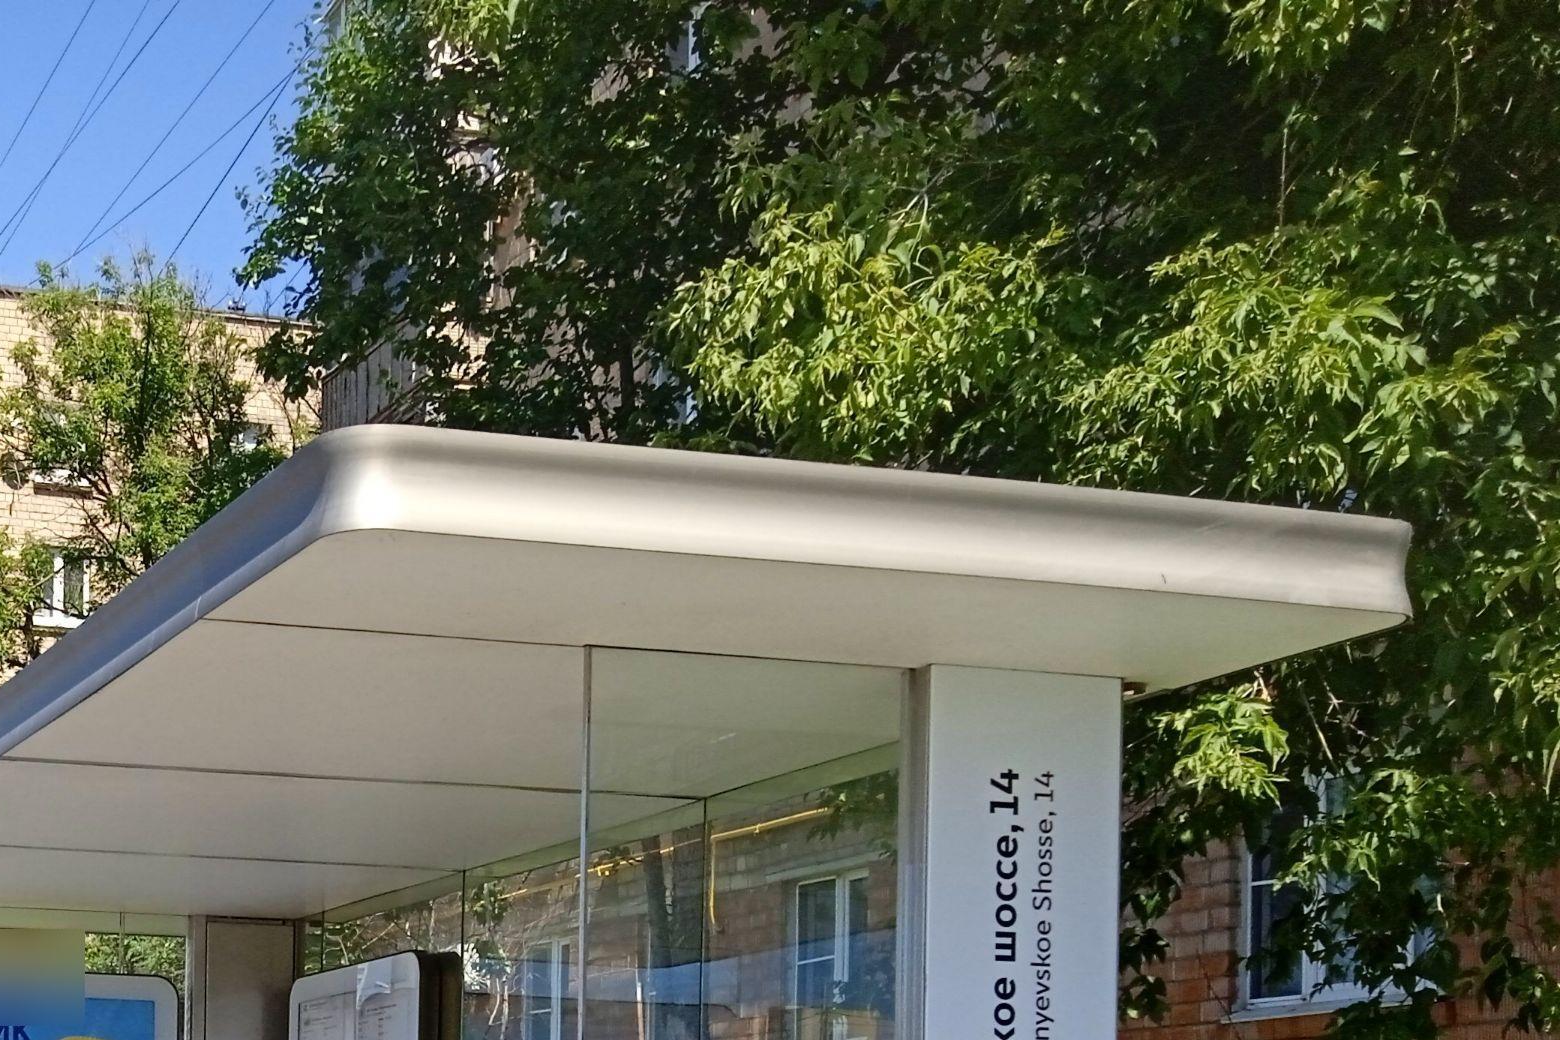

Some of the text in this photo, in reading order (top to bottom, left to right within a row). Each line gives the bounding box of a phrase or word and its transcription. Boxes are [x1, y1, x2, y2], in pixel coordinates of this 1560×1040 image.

[989, 768, 1020, 816] 14
[1033, 770, 1055, 803] 14
[994, 824, 1025, 963] шоссе,
[1031, 811, 1057, 911] Shosse,
